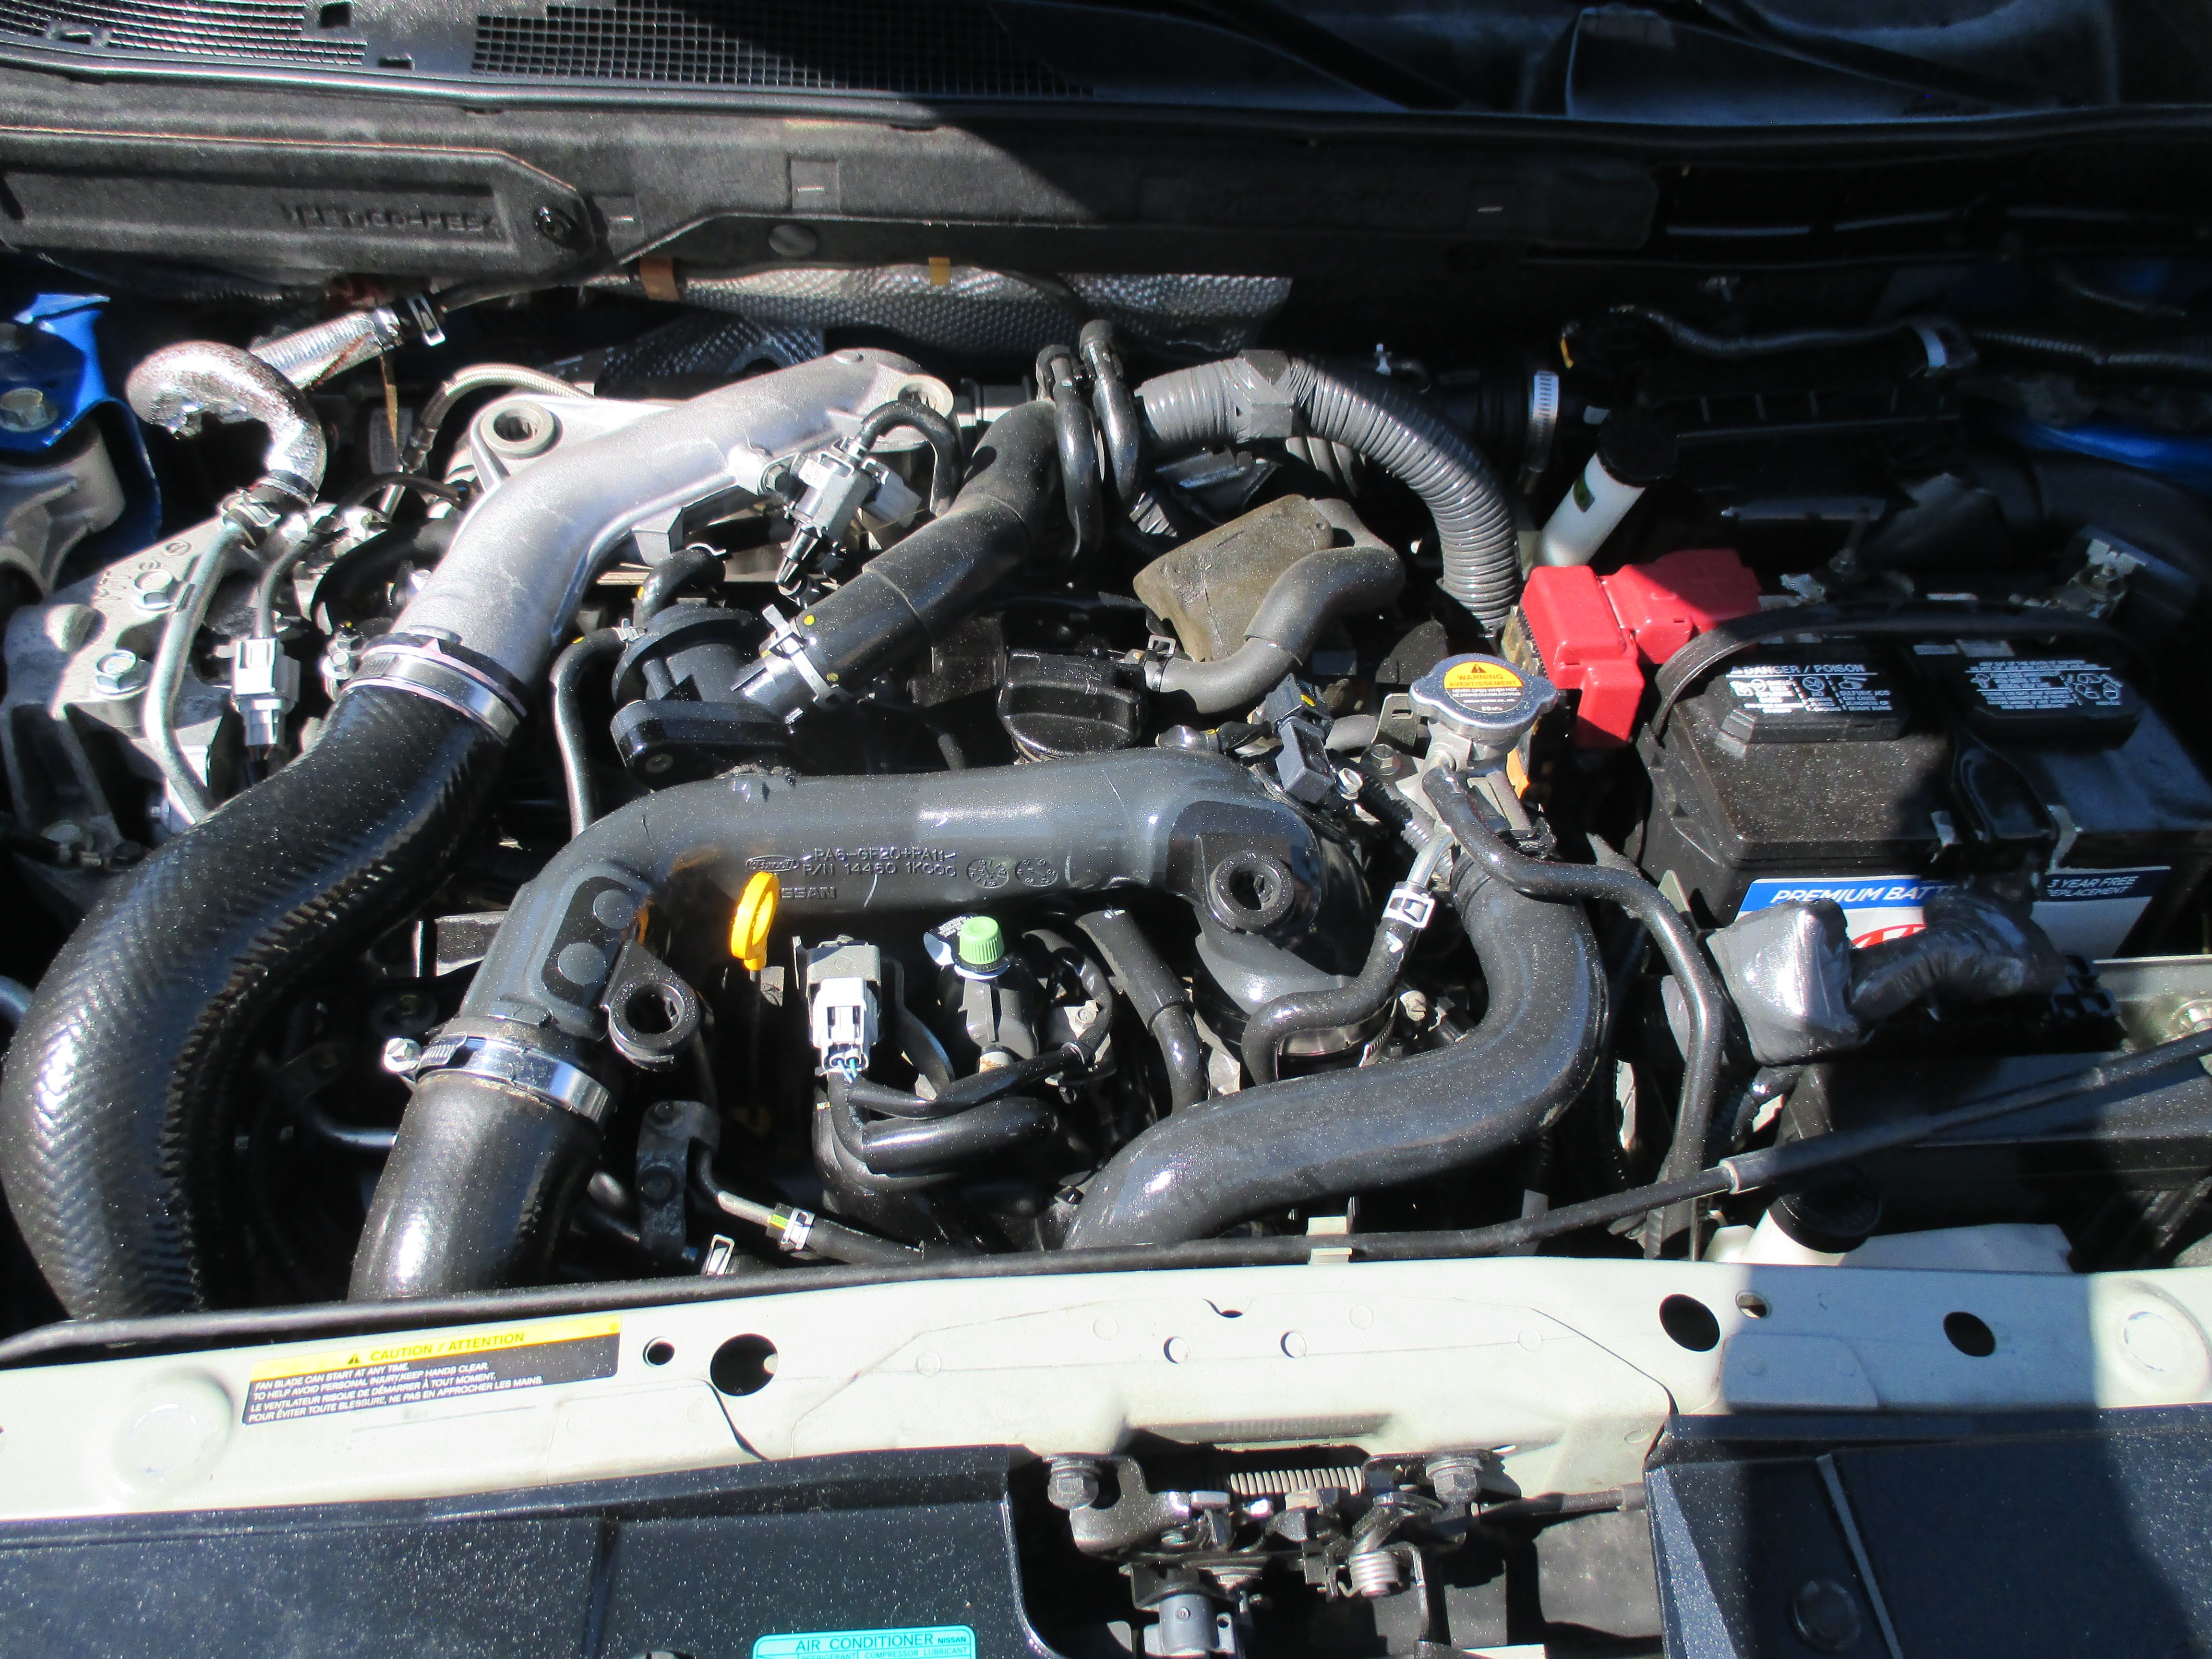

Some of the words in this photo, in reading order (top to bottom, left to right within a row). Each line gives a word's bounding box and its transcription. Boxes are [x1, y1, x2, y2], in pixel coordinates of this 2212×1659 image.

[1744, 665, 1801, 675] DANGER
[1803, 665, 1811, 674] /
[1813, 664, 1866, 673] POISON
[803, 863, 835, 876] P/N
[844, 862, 897, 875] 14460
[2047, 879, 2061, 888] 3
[2060, 878, 2101, 888] YEAR
[2099, 876, 2140, 886] FREE
[1769, 887, 1887, 903] PREMIUM
[371, 1344, 433, 1361] CAUTION
[437, 1343, 445, 1352] /
[448, 1332, 526, 1352] ATTENTION
[253, 1392, 266, 1401] TO
[267, 1389, 291, 1400] HELP
[291, 1385, 320, 1396] AVOID
[320, 1379, 369, 1393] PERSONAL
[425, 1366, 457, 1377] HANDS
[457, 1361, 490, 1373] CLEAR.
[255, 1381, 273, 1392] FAN
[274, 1377, 304, 1388] BLADE
[305, 1374, 325, 1384] CAN
[325, 1370, 354, 1381] START
[354, 1368, 368, 1378] AT
[367, 1366, 386, 1376] ANY
[387, 1362, 410, 1372] TIME.
[248, 1412, 276, 1423] POUR
[276, 1407, 307, 1419] ÉVITER
[308, 1402, 337, 1414] TOUTE
[337, 1396, 387, 1411] BLESSURE,
[388, 1393, 401, 1403] NE
[403, 1390, 421, 1401] PAS
[422, 1389, 439, 1399] EN
[438, 1383, 493, 1397] APPROCHER
[494, 1379, 511, 1389] LES
[512, 1375, 545, 1387] MAINS.
[251, 1404, 264, 1413] LE
[264, 1396, 321, 1411] VENTILATEUR
[321, 1391, 356, 1403] RISQUE
[357, 1388, 371, 1398] DE
[371, 1381, 422, 1396] DÉMARRER
[421, 1380, 430, 1389] À
[431, 1376, 456, 1388] TOUT
[455, 1371, 497, 1384] MOMENT.
[795, 1639, 820, 1652] AIR
[830, 1633, 934, 1650] CONDITIONER
[865, 1649, 919, 1659] COMPRESSOR
[924, 1647, 968, 1656] LUBRICANT
